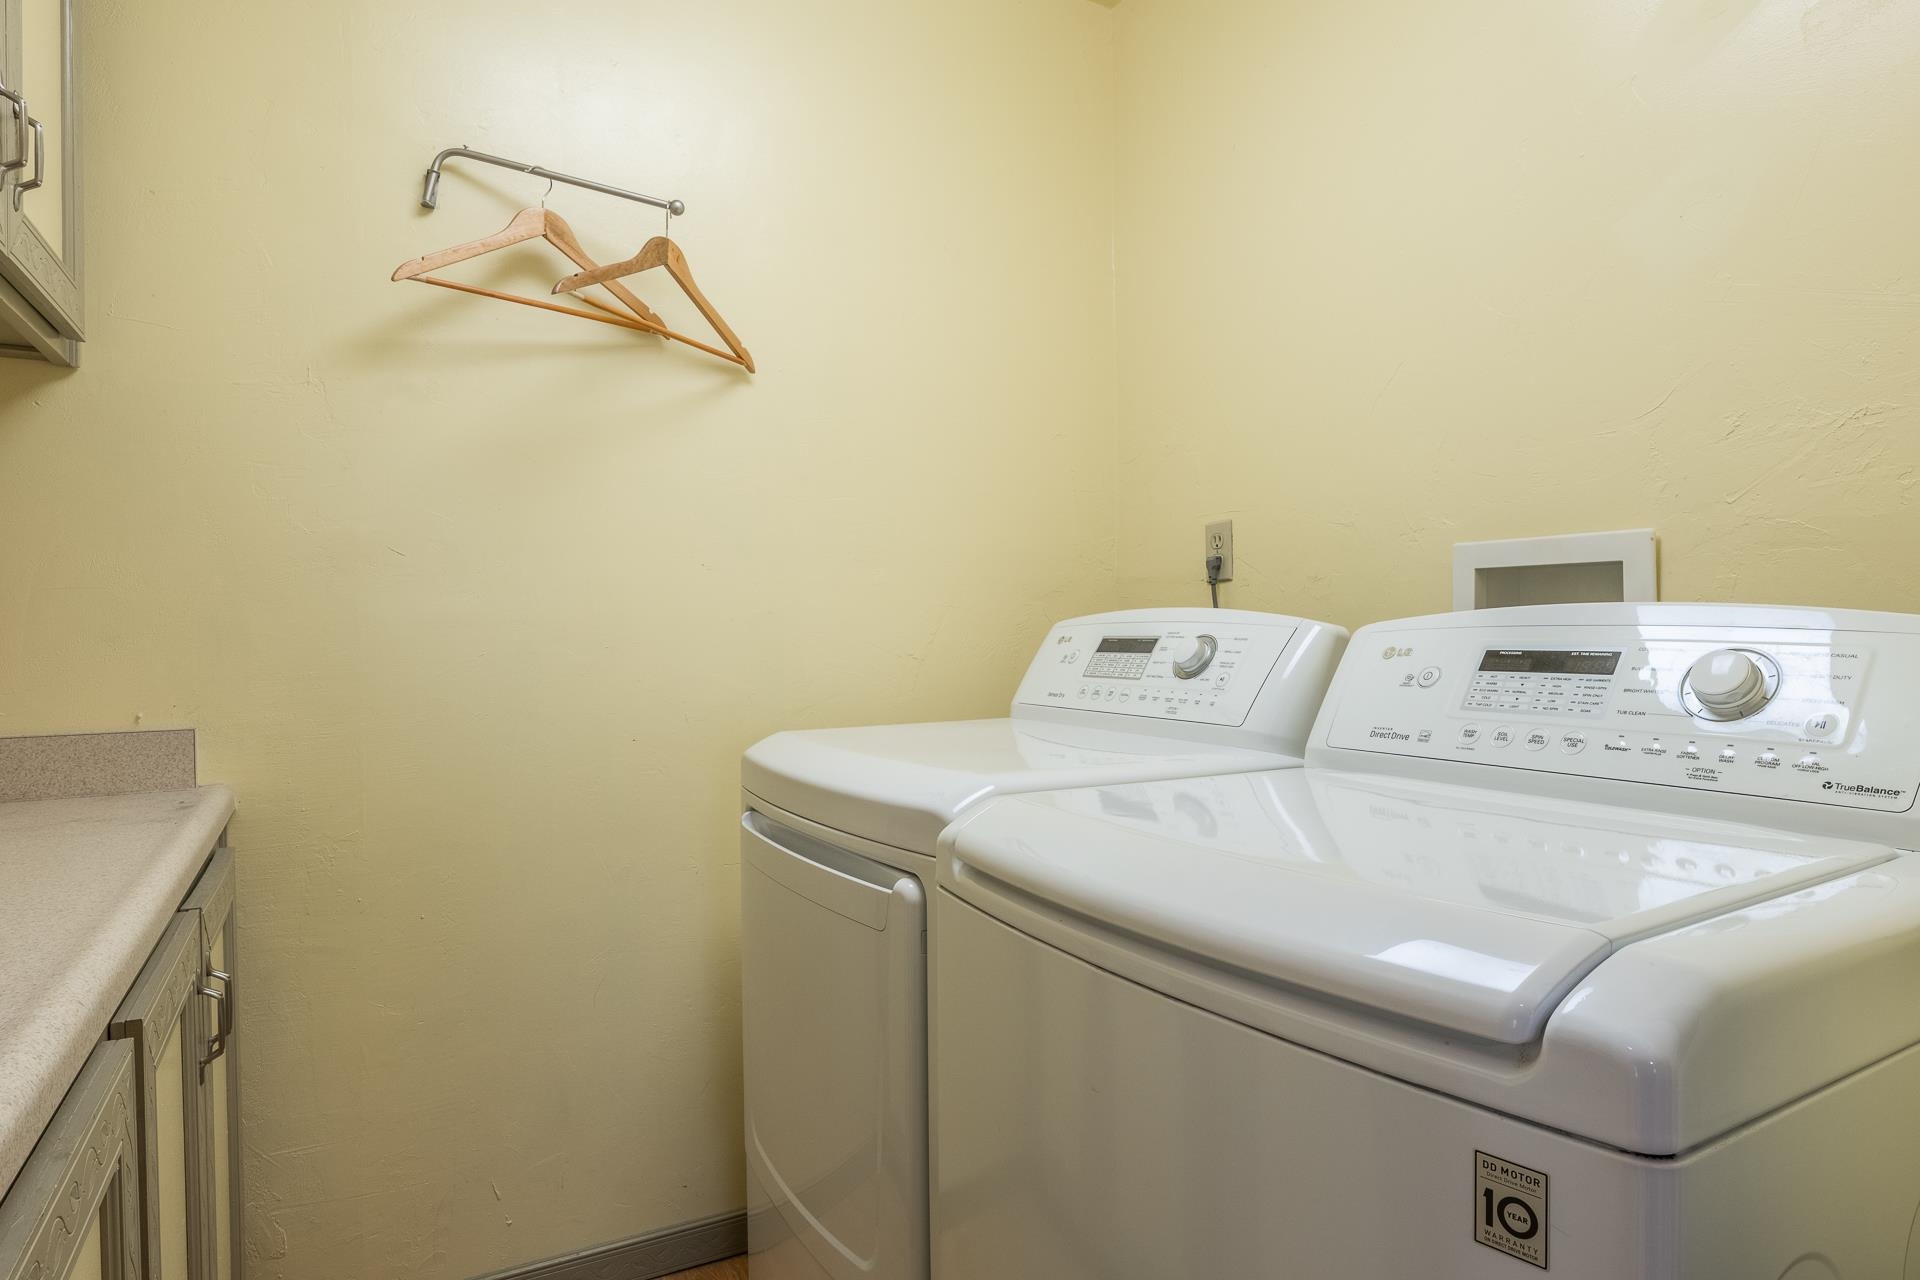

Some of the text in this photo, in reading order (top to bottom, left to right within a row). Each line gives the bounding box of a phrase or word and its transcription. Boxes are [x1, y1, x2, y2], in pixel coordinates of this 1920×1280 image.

[1562, 736, 1585, 744] SPECIAL
[1691, 767, 1715, 775] OPTION
[1482, 1159, 1541, 1188] DD MOTOR
[1486, 1171, 1538, 1193] Direct Drive Motor
[1482, 1186, 1539, 1241] 10
[1506, 1210, 1529, 1226] YEAR
[1484, 1228, 1539, 1256] WARRANTY
